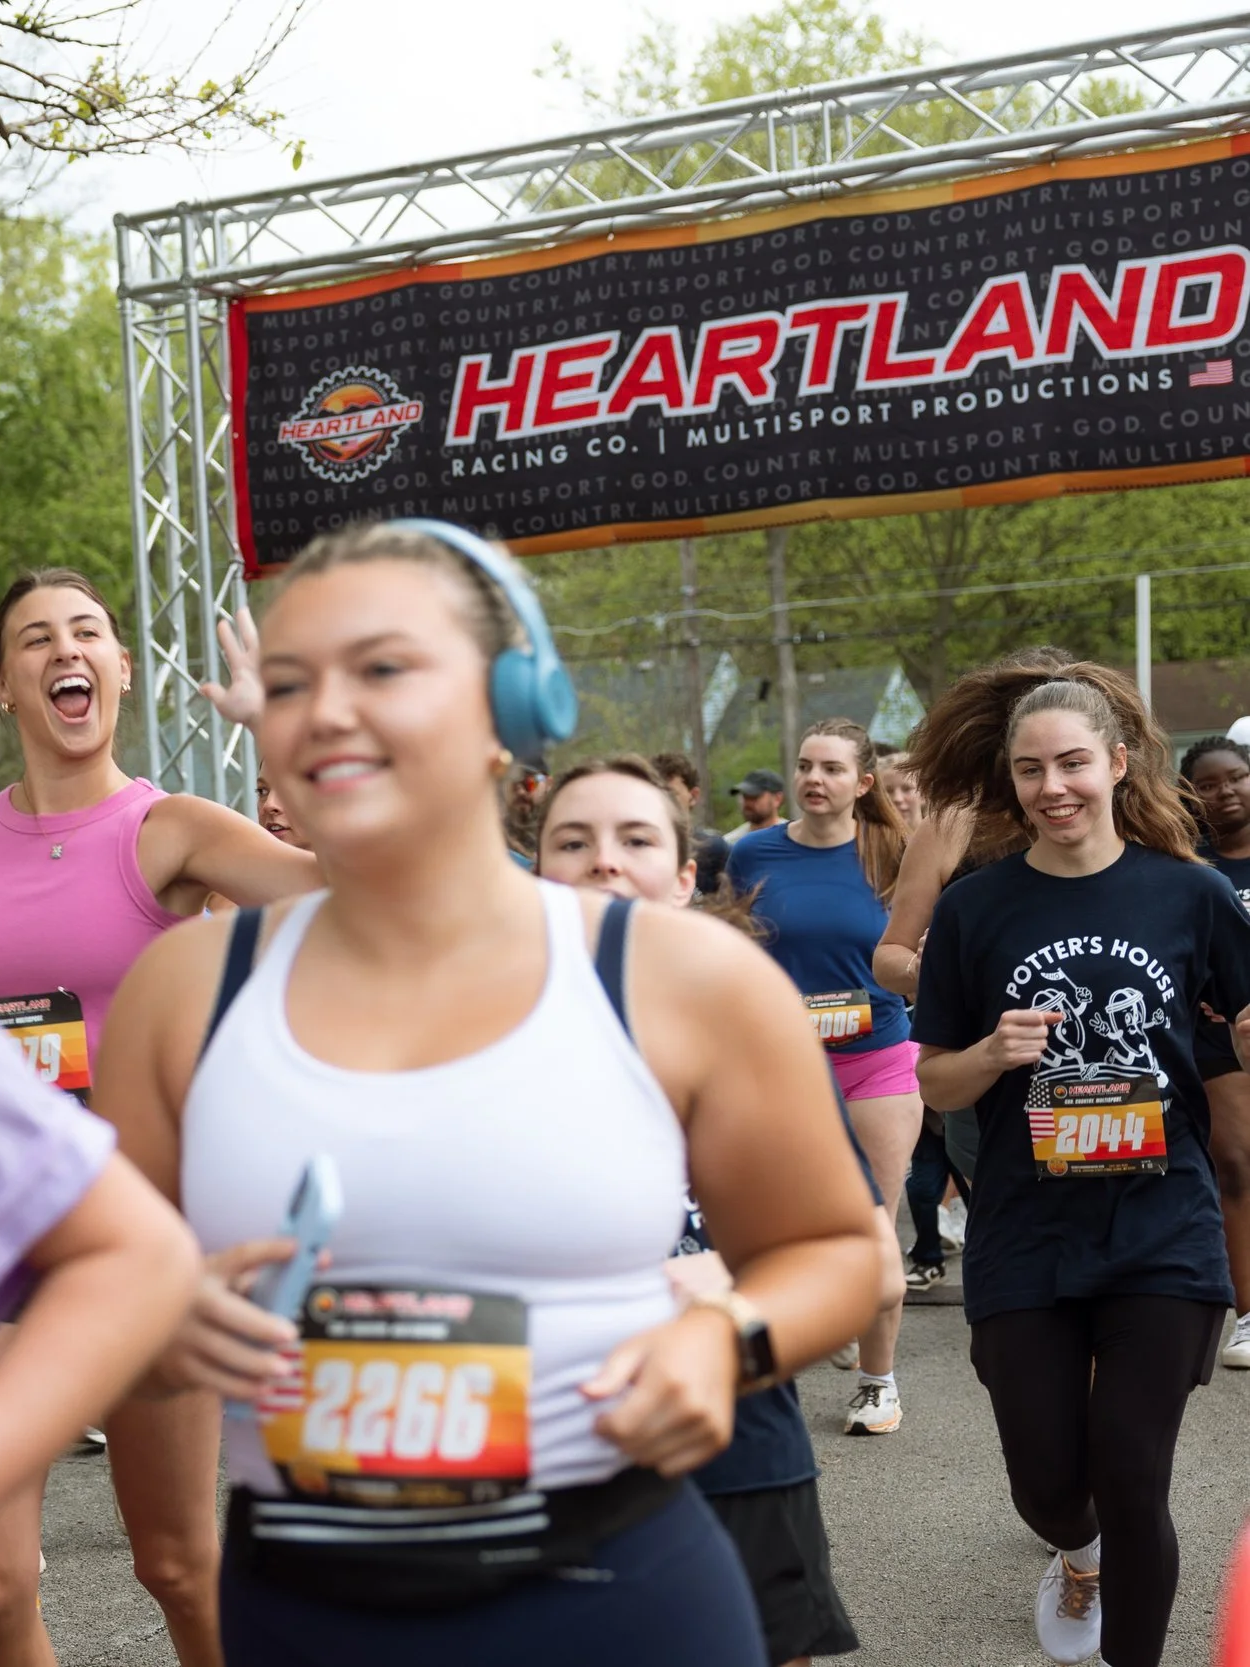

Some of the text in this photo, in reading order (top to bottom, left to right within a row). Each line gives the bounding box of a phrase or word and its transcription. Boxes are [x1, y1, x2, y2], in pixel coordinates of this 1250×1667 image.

[263, 288, 417, 329] MULTISPORT
[508, 254, 636, 292] COUNTRY.
[647, 223, 823, 268] MULTISPORT
[850, 215, 915, 236] GOD.
[929, 185, 1075, 227] COUNTRY.
[439, 295, 564, 325] COUNTRY.
[574, 267, 745, 306] MULTISPORT
[848, 229, 990, 263] COUNTRY.
[1004, 198, 1203, 240] MULTISPORT
[439, 312, 603, 352] MULTISPORT
[701, 276, 837, 315] COUNTRY.
[848, 246, 1037, 291] MULTISPORT
[445, 243, 1249, 447] HEARTLAND
[280, 402, 422, 442] HEARTLAND
[443, 476, 607, 514] MULTISPORT
[704, 447, 841, 482] COUNTRY.
[853, 423, 1044, 463] MULTISPORT
[451, 444, 569, 477] RACING
[586, 435, 639, 457] CO.
[686, 402, 892, 448] MULTISPORT
[911, 368, 1174, 419] PRODUCTIONS
[652, 477, 828, 517] MULTISPORT
[1005, 935, 1175, 1003] POTTER'S HOUSE
[1055, 1112, 1145, 1154] 2044
[303, 1359, 493, 1461] 2266
